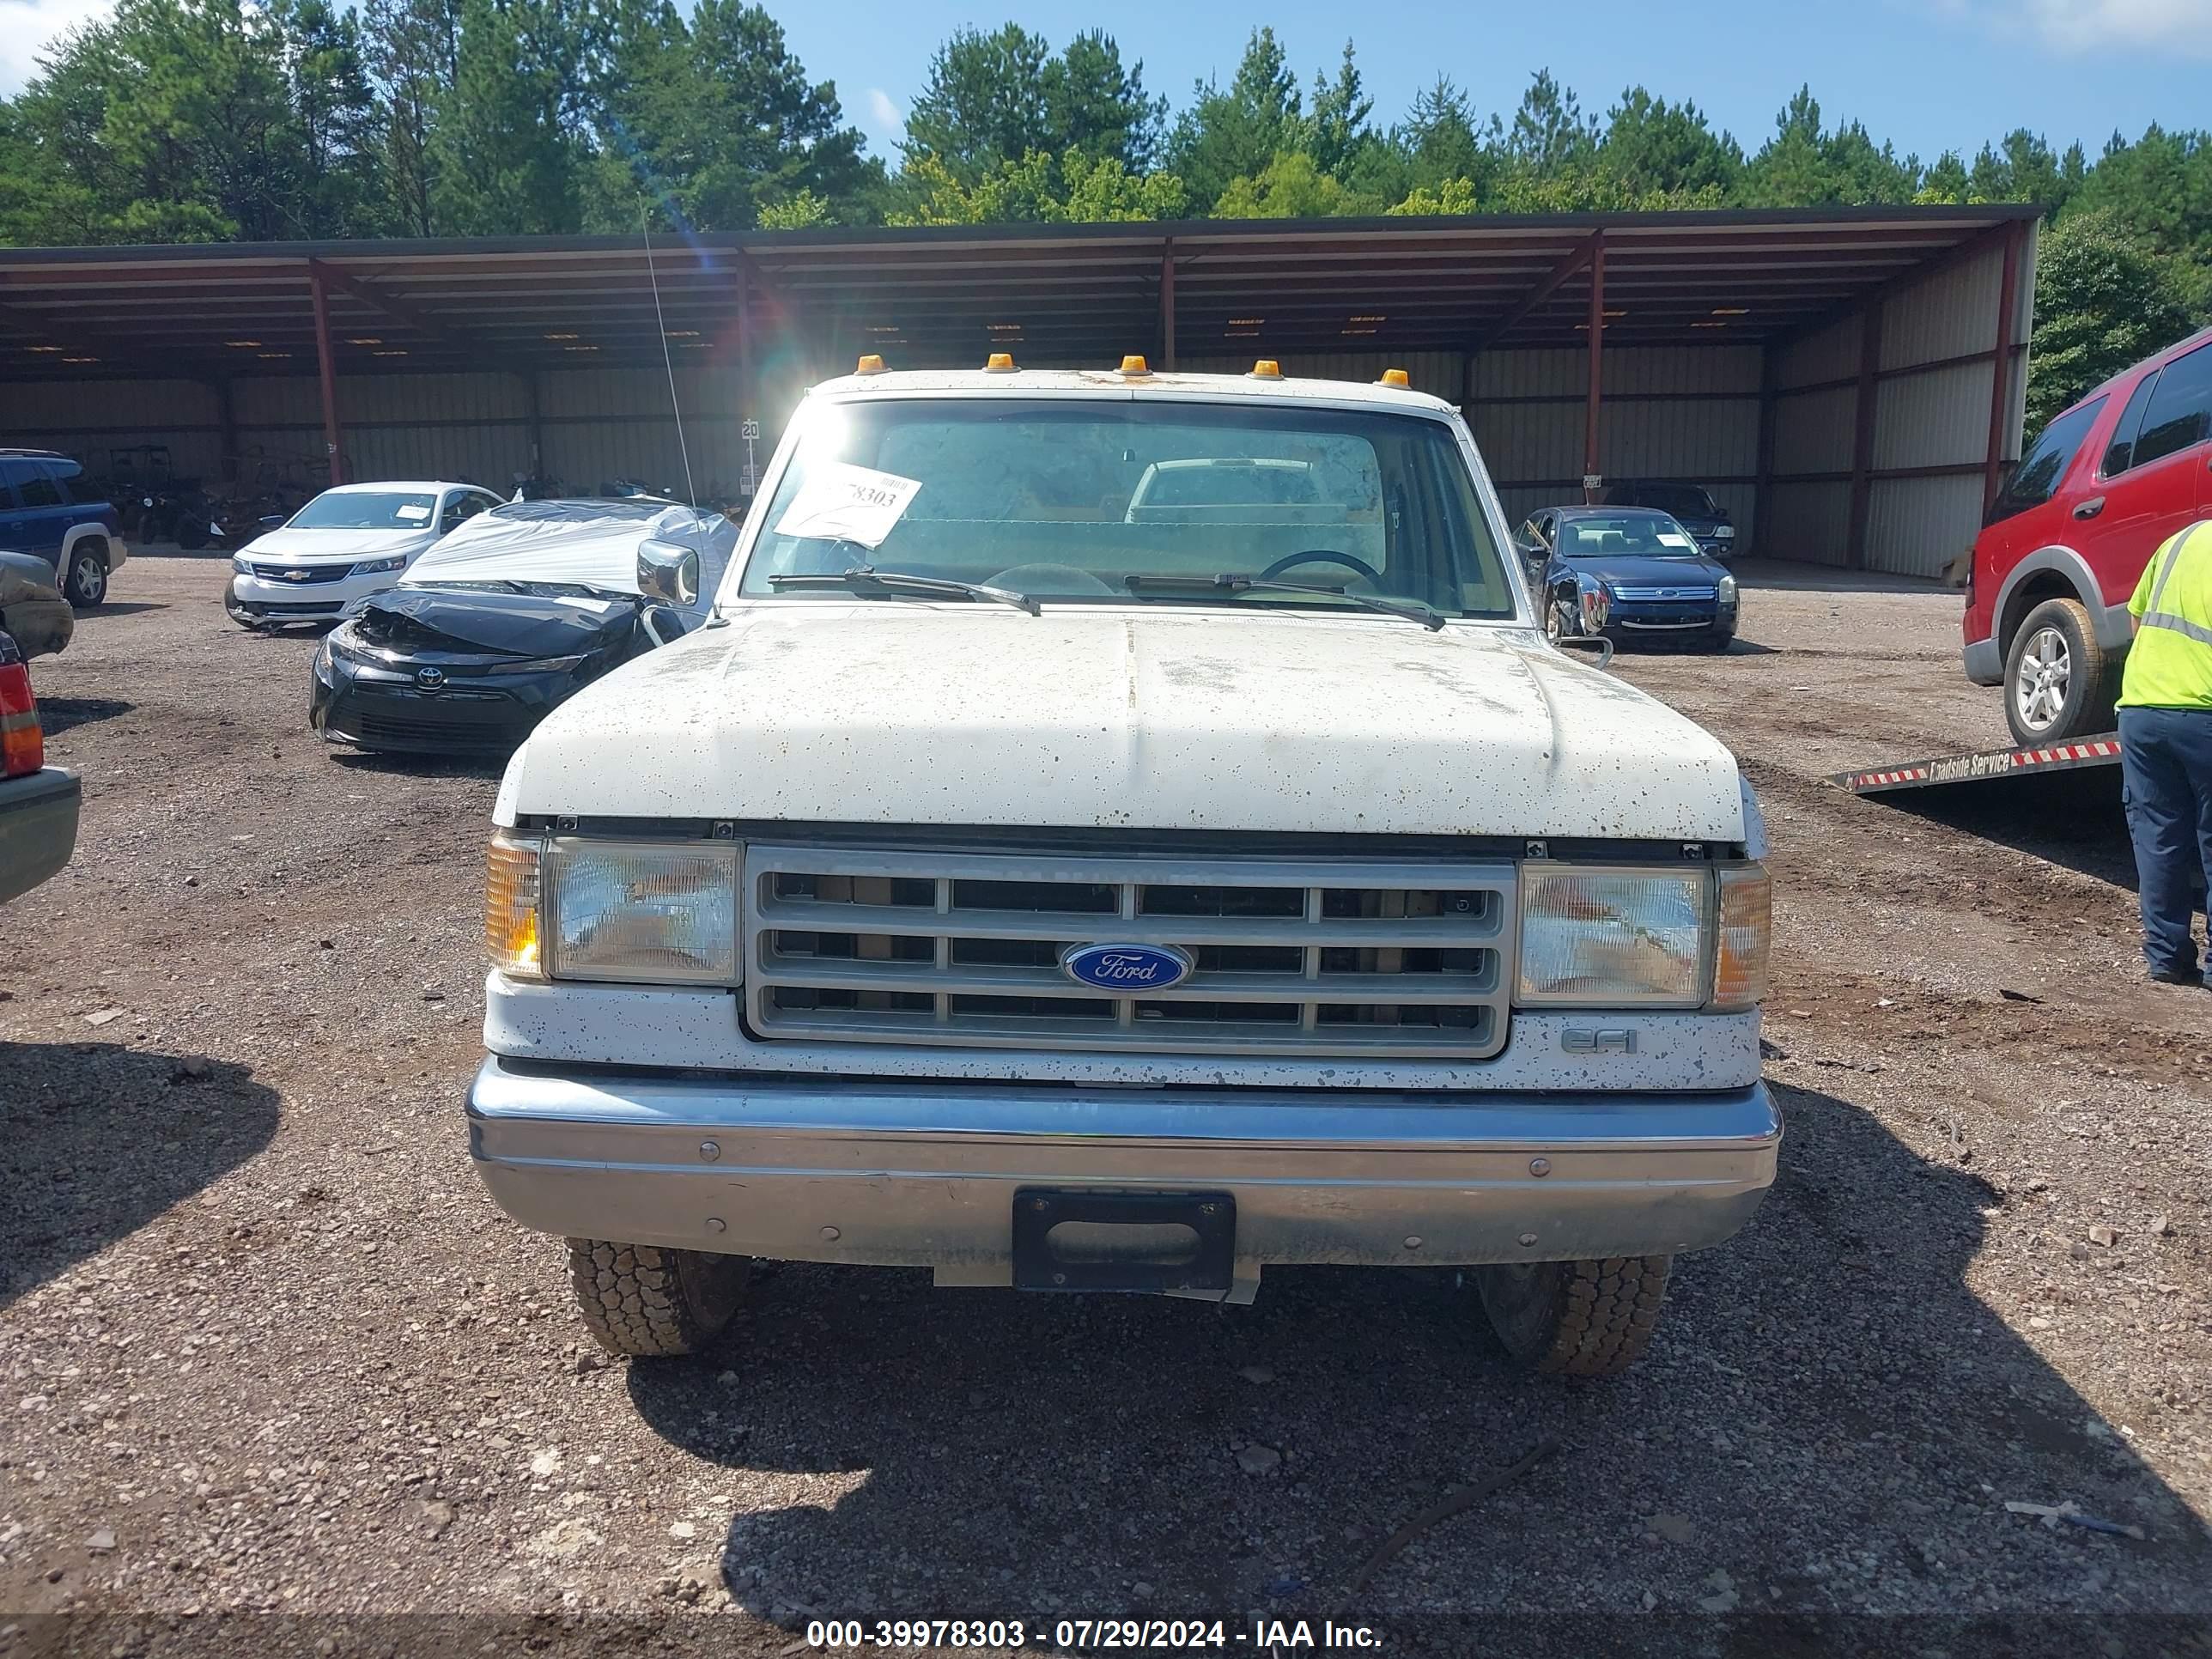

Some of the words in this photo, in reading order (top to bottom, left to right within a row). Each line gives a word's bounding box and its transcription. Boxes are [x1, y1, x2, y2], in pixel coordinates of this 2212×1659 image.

[743, 423, 758, 436] 20
[1971, 751, 2009, 776] Service
[1094, 953, 1158, 981] Ford
